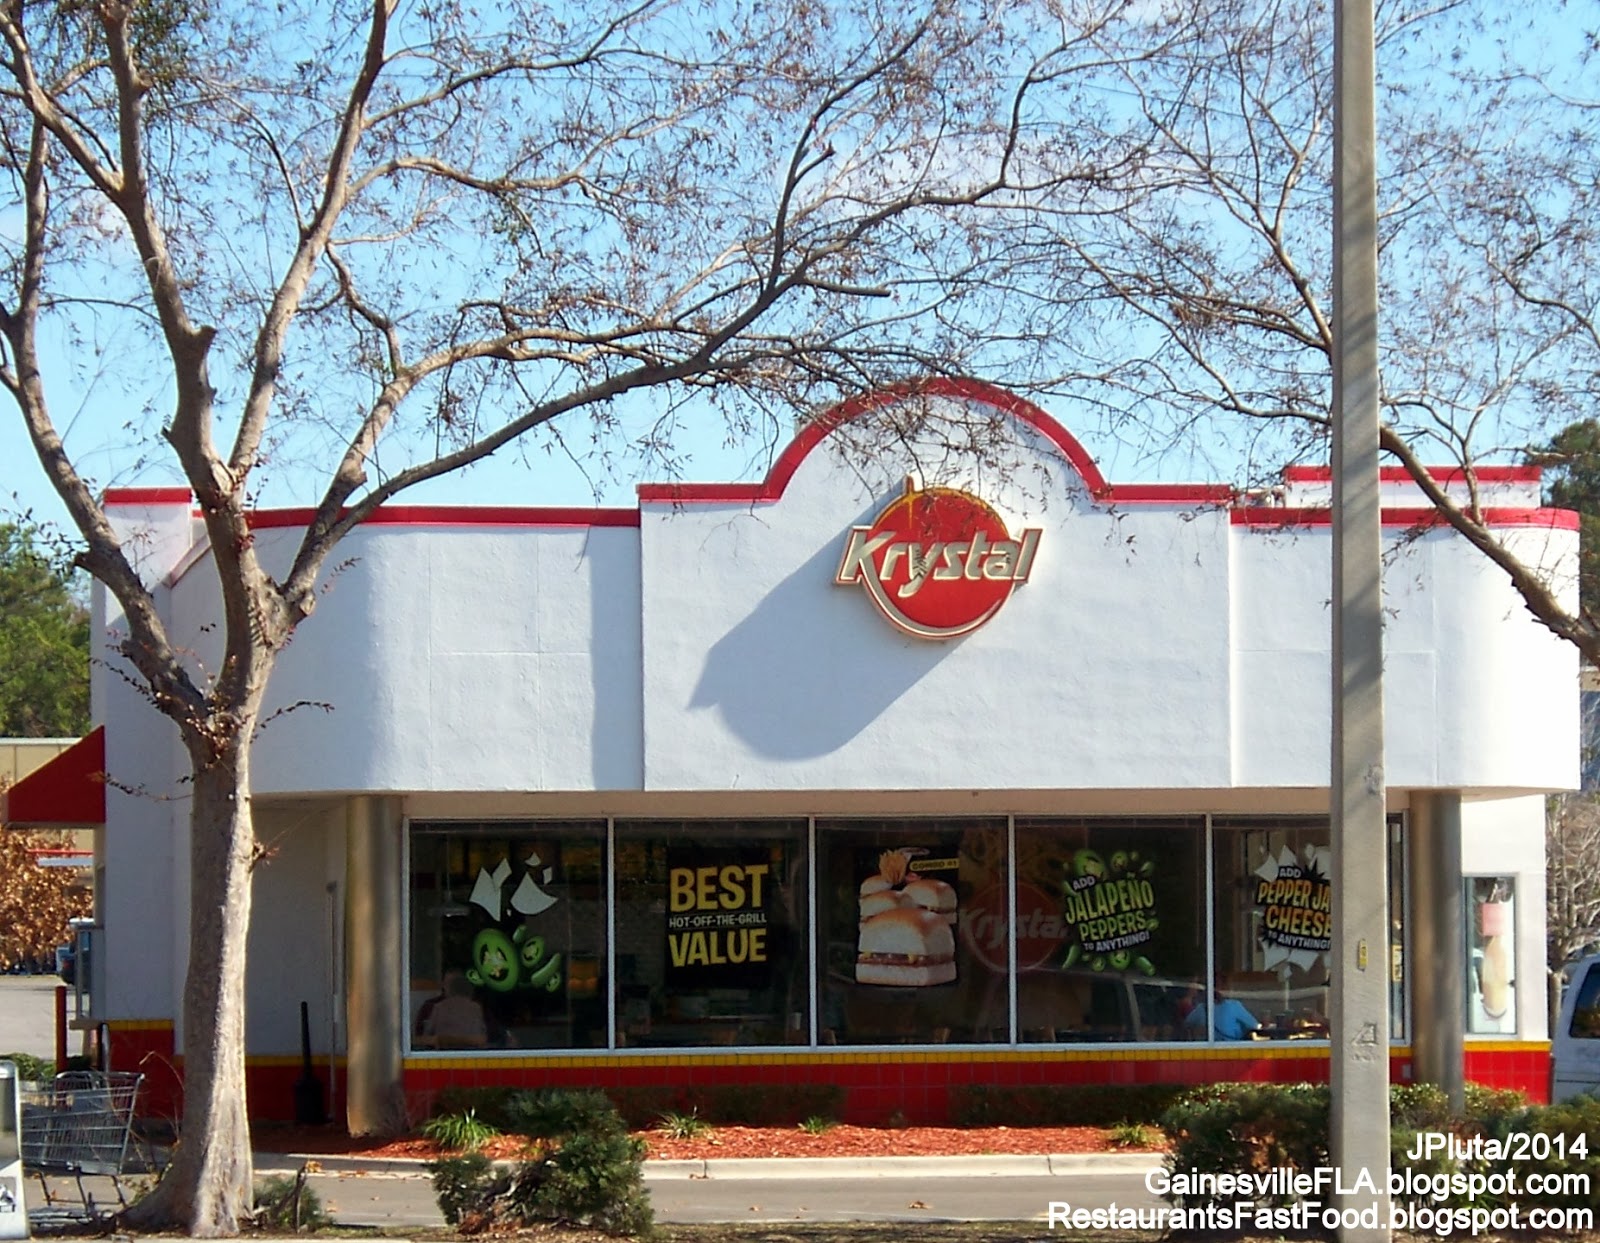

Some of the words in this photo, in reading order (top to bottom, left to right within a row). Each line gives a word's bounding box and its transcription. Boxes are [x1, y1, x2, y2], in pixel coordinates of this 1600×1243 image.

[836, 527, 1043, 598] Krystal
[1073, 876, 1095, 890] ADD
[1280, 867, 1302, 878] ADD
[670, 864, 769, 912] BEST
[1258, 880, 1312, 907] PEPPER
[1312, 884, 1331, 911] JA
[668, 912, 767, 928] HOT-OFF-THE-GRILL
[1080, 911, 1147, 941] PEPPERS
[668, 928, 767, 967] VALUE
[1096, 931, 1150, 951] ANYTHING!
